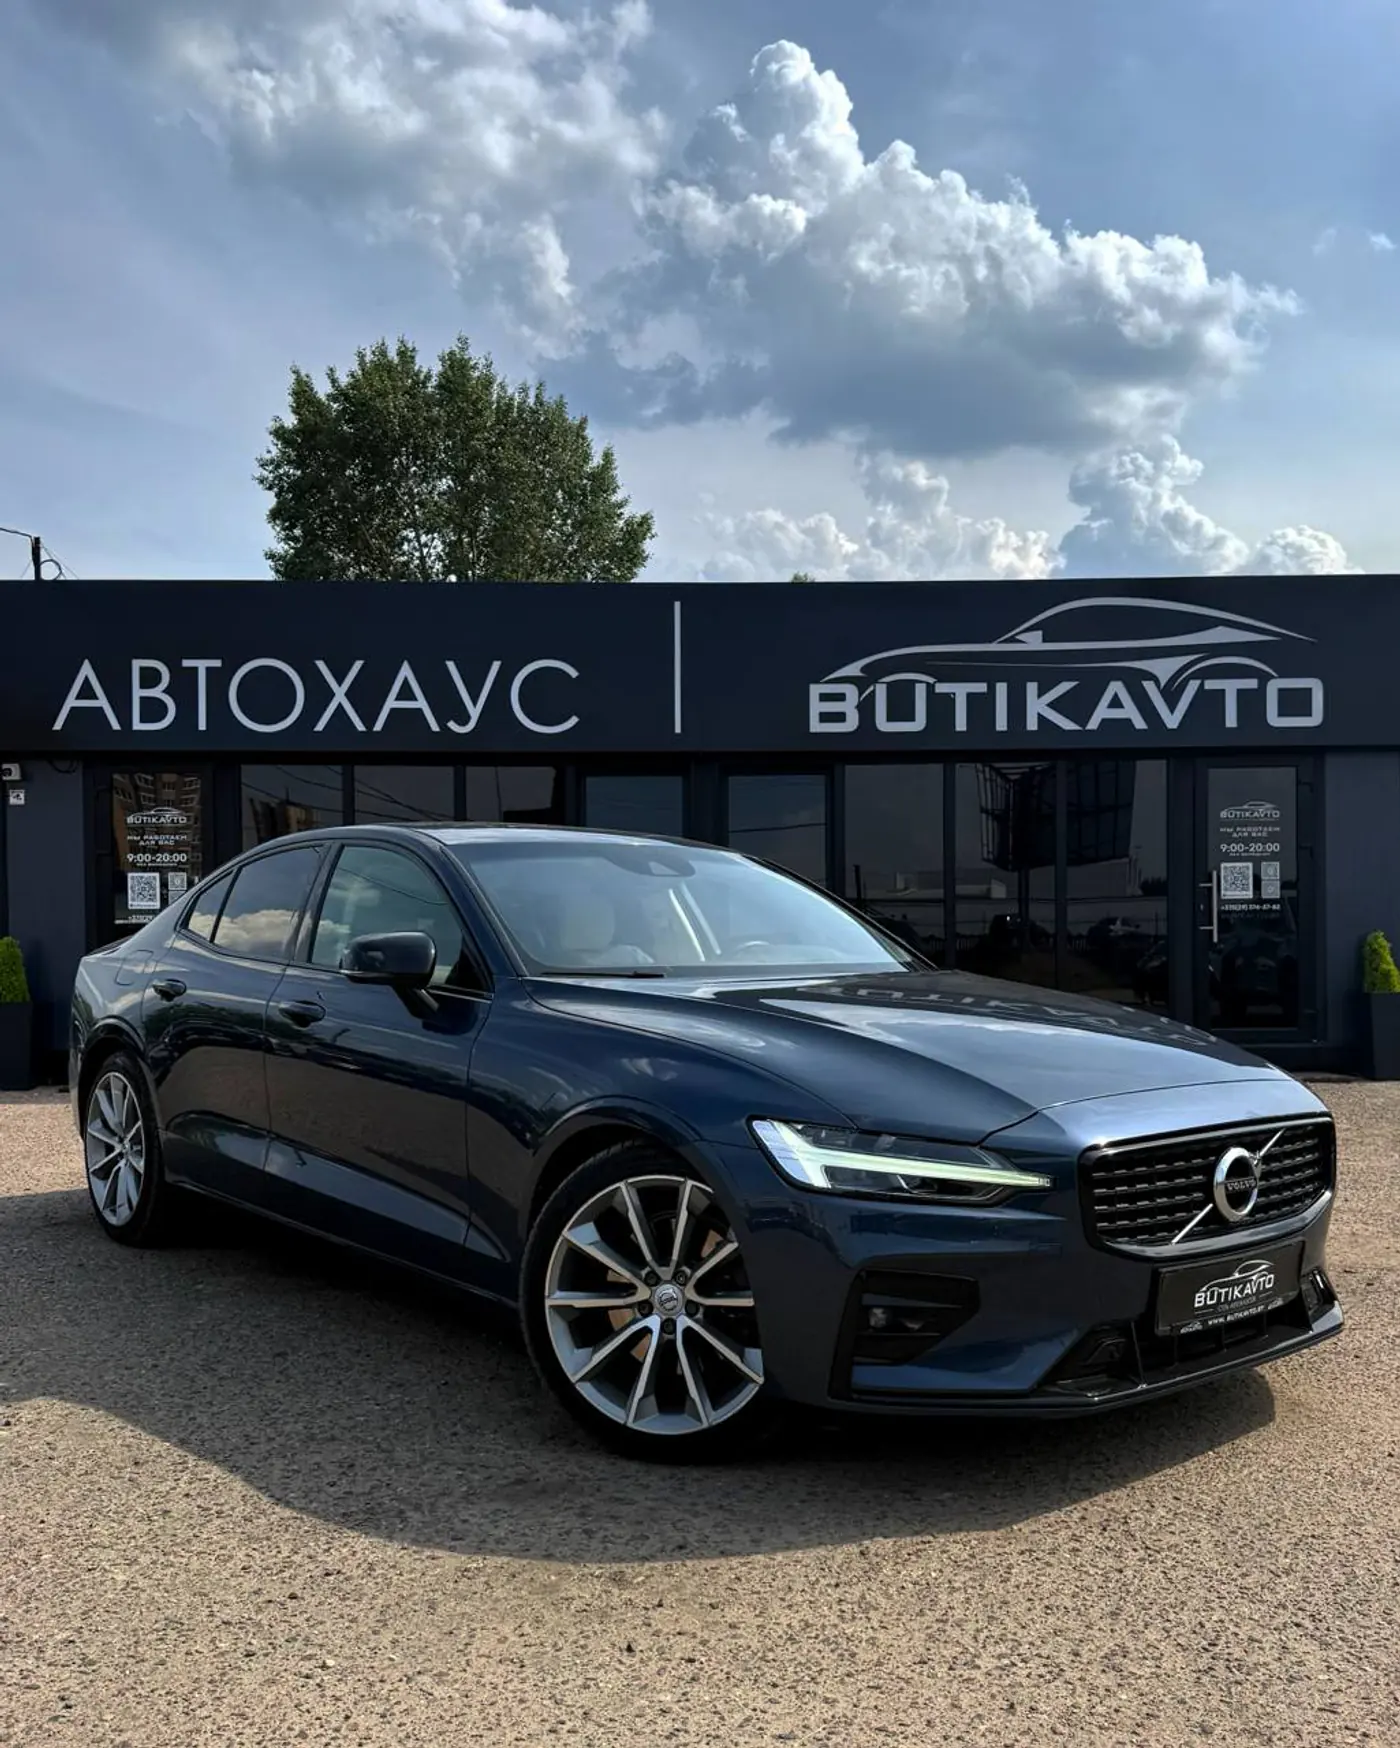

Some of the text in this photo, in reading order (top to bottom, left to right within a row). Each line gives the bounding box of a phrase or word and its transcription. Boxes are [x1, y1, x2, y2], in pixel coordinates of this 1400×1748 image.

[52, 657, 580, 733] АВТОХАУС
[808, 677, 1324, 734] BUTIKAVTO
[127, 853, 187, 862] 9:00-20:00
[1220, 843, 1280, 852] 9:00-20:00
[1194, 1273, 1275, 1308] BUTIKAVTO
